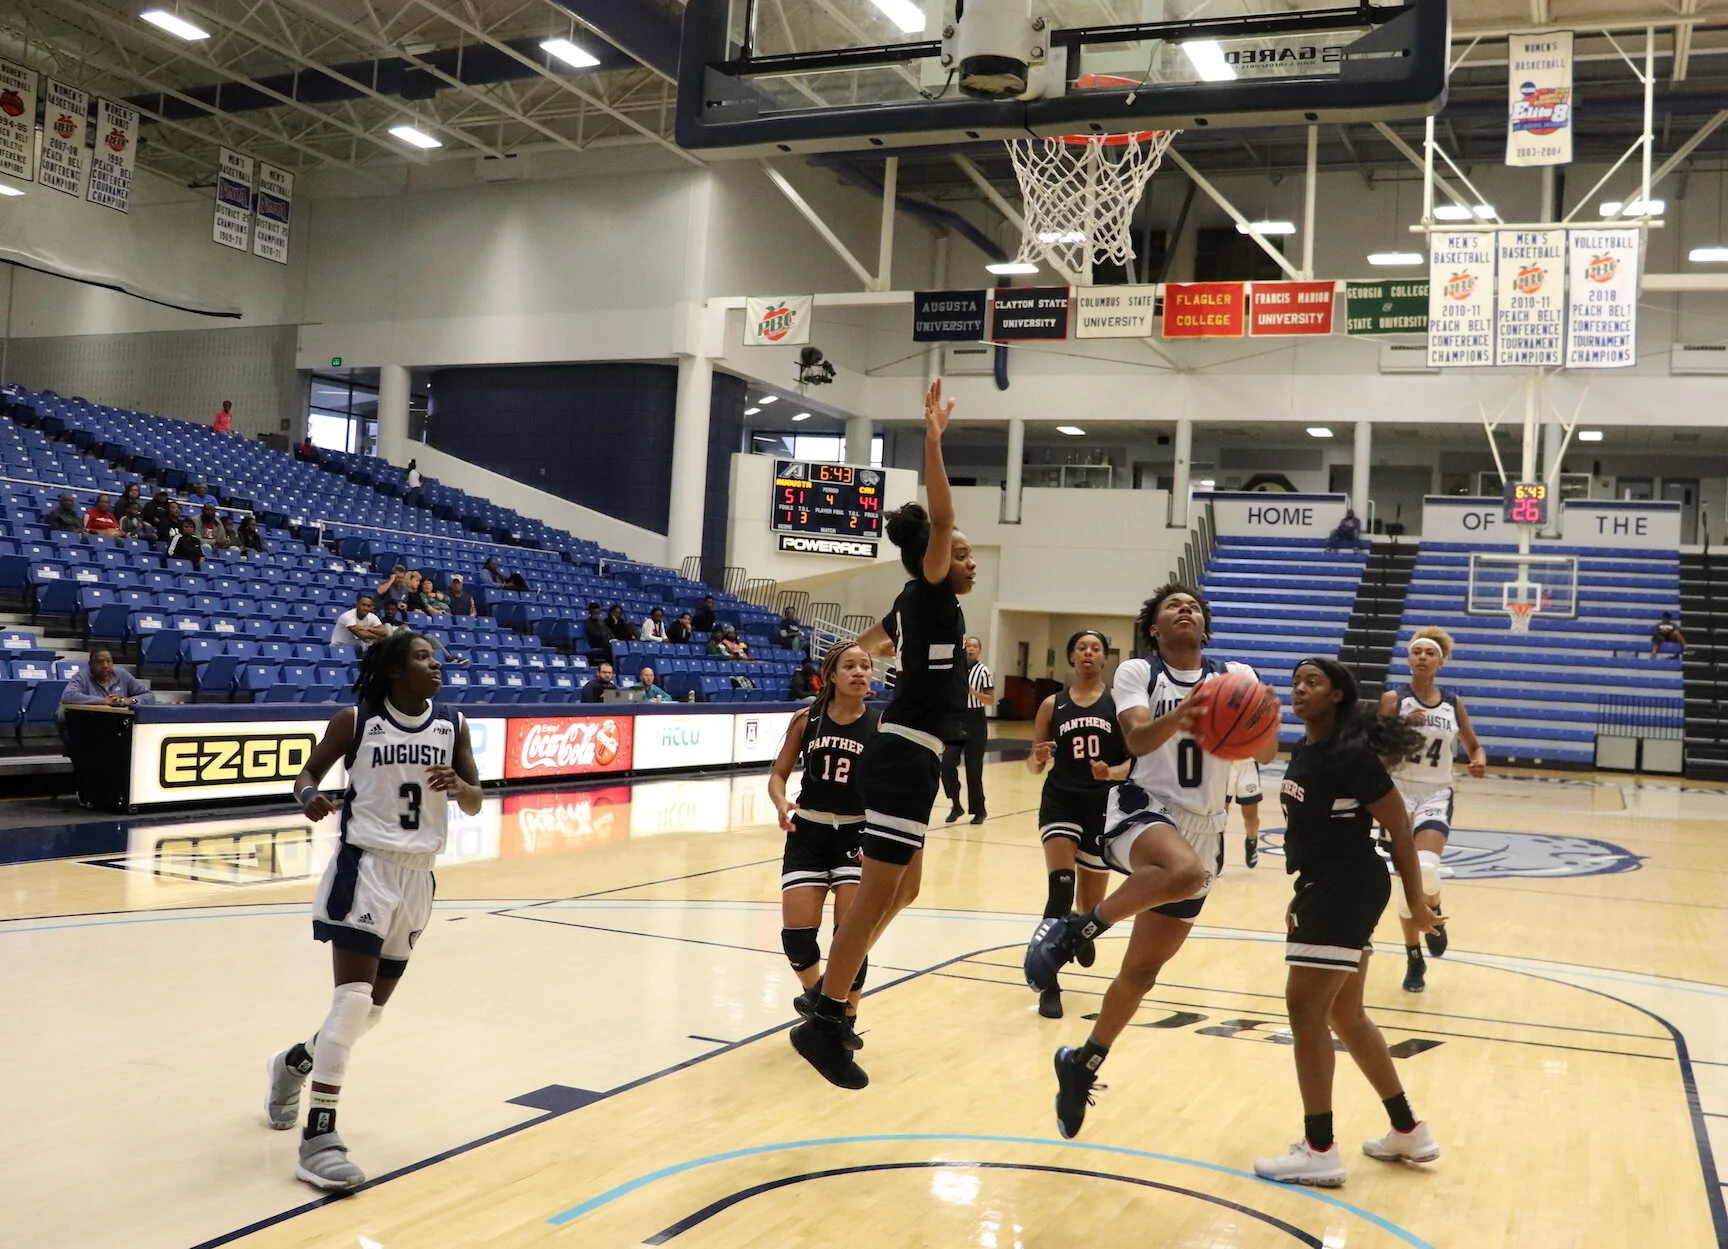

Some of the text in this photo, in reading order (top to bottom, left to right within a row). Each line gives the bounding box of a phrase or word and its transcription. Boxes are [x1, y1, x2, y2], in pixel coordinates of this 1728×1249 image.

[1515, 59, 1566, 70] BASKETBALL
[0, 74, 31, 92] ASKETBALL
[0, 116, 27, 132] 994-95
[0, 149, 26, 164] NFERENCE
[1517, 147, 1561, 158] 2003-2004
[108, 154, 123, 166] 1992
[92, 170, 130, 188] CONFERENC
[120, 167, 131, 180] BEL
[92, 180, 128, 199] TOURNAMEN
[92, 191, 127, 209] CHAMPION
[1448, 237, 1478, 248] MEN'S
[1516, 233, 1548, 245] MEN'S
[1574, 236, 1633, 248] VOLLEYBALL
[1434, 252, 1490, 264] BASKETBALL
[1502, 246, 1560, 258] BASKETBALL
[1255, 291, 1330, 305] FRANCIS MARION
[1347, 284, 1429, 299] GEORGIA COLLEGE
[1589, 290, 1616, 302] 2018
[995, 298, 1067, 310] CLAYTON STATE
[1080, 296, 1151, 308] COLUMBUS STATE
[1176, 294, 1231, 306] FLAGLER
[1511, 296, 1550, 308] 2010-11
[922, 301, 978, 313] AUGUSTA
[1442, 305, 1480, 316] 2010-11
[1573, 304, 1631, 317] PEACH BELT
[1084, 316, 1146, 328] UNIVERSITY
[1176, 314, 1230, 326] COLLEGE
[1258, 313, 1324, 326] UNIVERSITY
[1500, 309, 1560, 322] PEACH BELT
[916, 320, 982, 332] UNIVERSITY
[1002, 318, 1057, 328] UNIVERSITY
[1348, 316, 1428, 330] STATE UNIVERSITY
[1430, 319, 1491, 332] PEACH BELT
[1572, 320, 1631, 332] CONFERENCE
[1500, 324, 1560, 336] CONFERENCE
[1432, 335, 1489, 347] CONFERENCE
[1501, 337, 1559, 349] TOURNAMENT
[1573, 335, 1630, 348] TOURNAMENT
[1432, 350, 1489, 362] CHAMPIONS
[1501, 351, 1558, 363] CHAMPIONS
[1571, 350, 1630, 362] CHAMPIONS
[820, 465, 852, 483] 6:43
[785, 488, 804, 504] 51
[1515, 485, 1546, 499] 6:43
[826, 494, 834, 505] 4
[859, 496, 878, 510] 44
[1512, 499, 1540, 521] 26
[800, 512, 808, 524] 3
[849, 516, 858, 528] 2
[1248, 508, 1648, 536] HOME OF THE
[783, 538, 873, 556] POWERADE
[1060, 716, 1112, 736] PANTHERS
[1424, 714, 1452, 732] USTA
[522, 723, 600, 770] Coca-Cola
[808, 736, 864, 755] PANTHER
[1072, 734, 1100, 760] 20
[822, 754, 851, 784] 12
[1177, 738, 1203, 788] 0
[1281, 779, 1304, 802] HERS
[399, 783, 422, 830] 3
